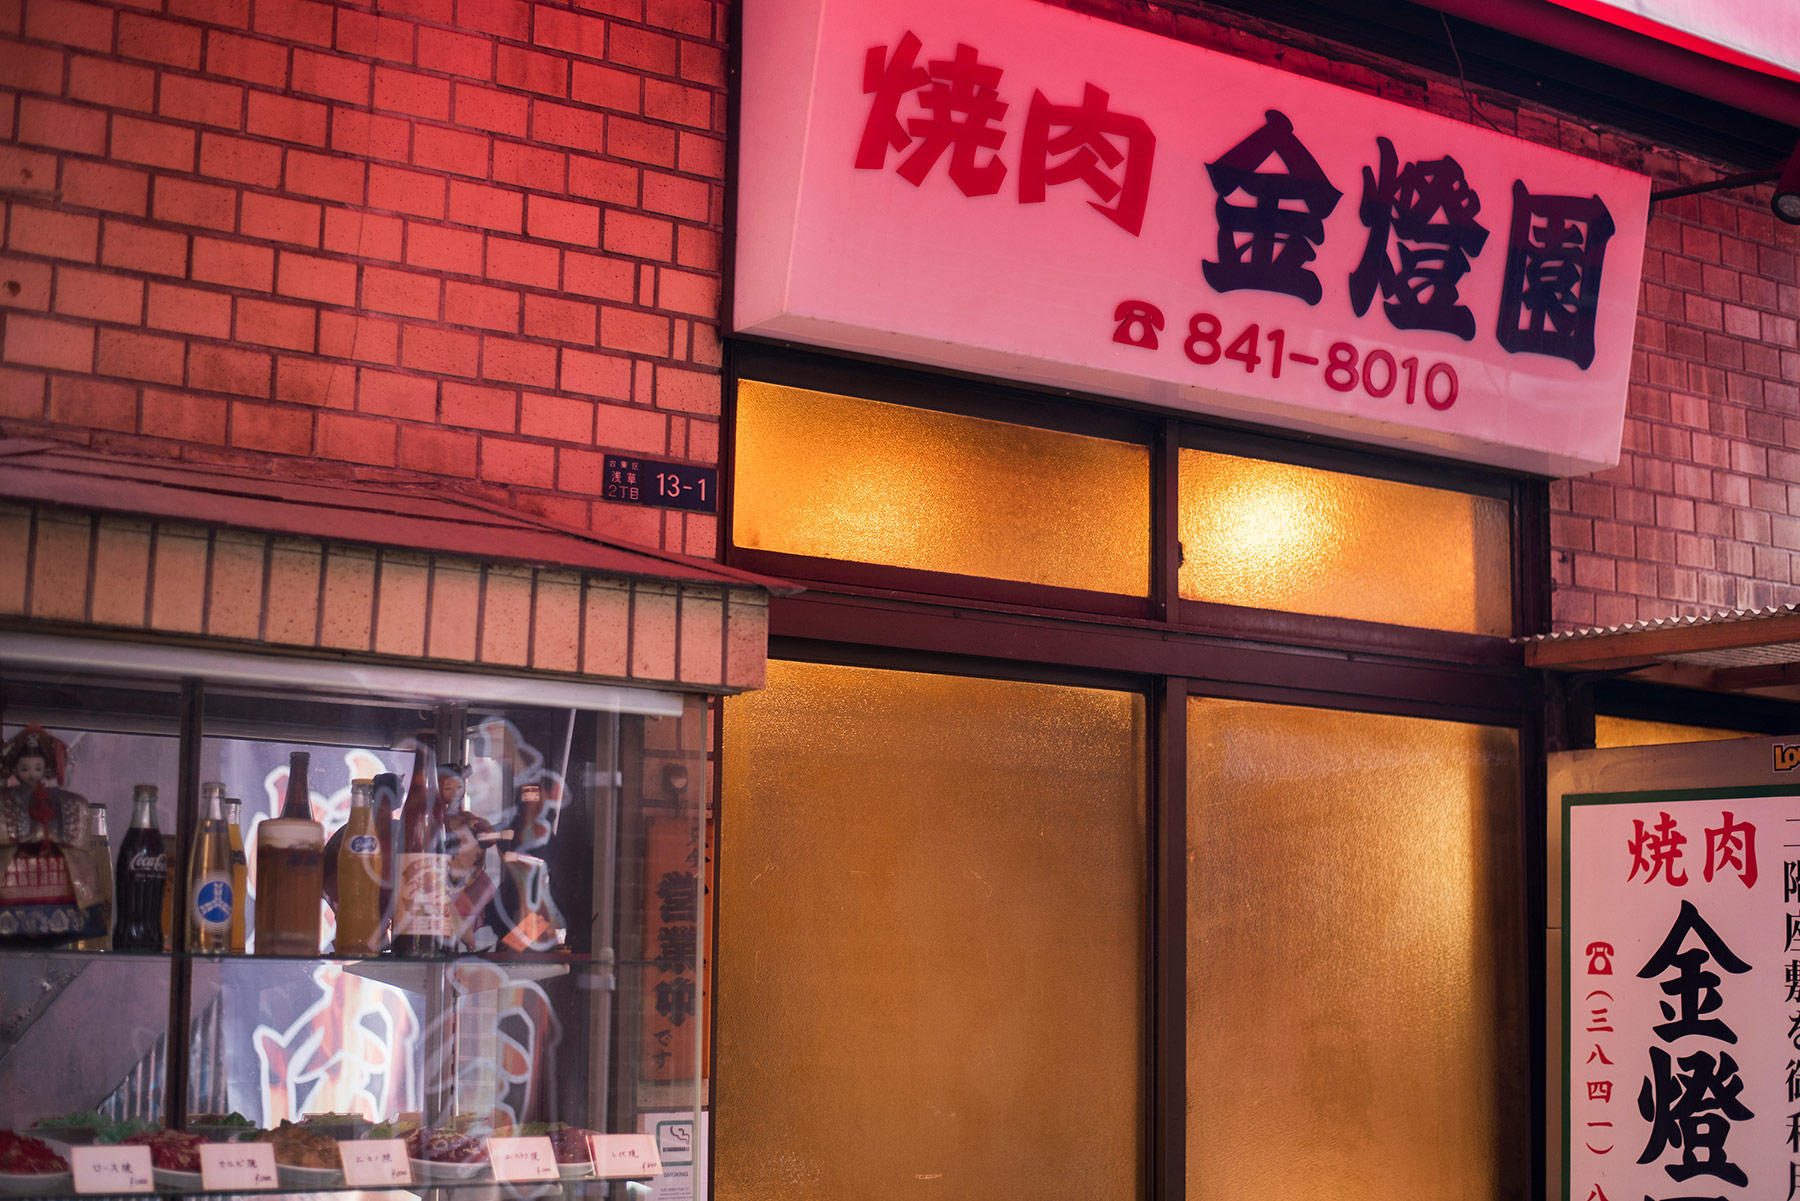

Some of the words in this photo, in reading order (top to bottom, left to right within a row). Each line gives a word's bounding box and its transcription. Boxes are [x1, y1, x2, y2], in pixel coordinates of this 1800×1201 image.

[854, 30, 1156, 237] 焼肉
[1202, 109, 1616, 371] 金燈園
[1184, 312, 1459, 411] 841-8010
[608, 484, 639, 500] 2丁目
[611, 470, 637, 485] 浅草
[657, 472, 706, 501] 13-1
[1627, 811, 1758, 889] 焼肉
[1636, 899, 1755, 1201] 金燈
